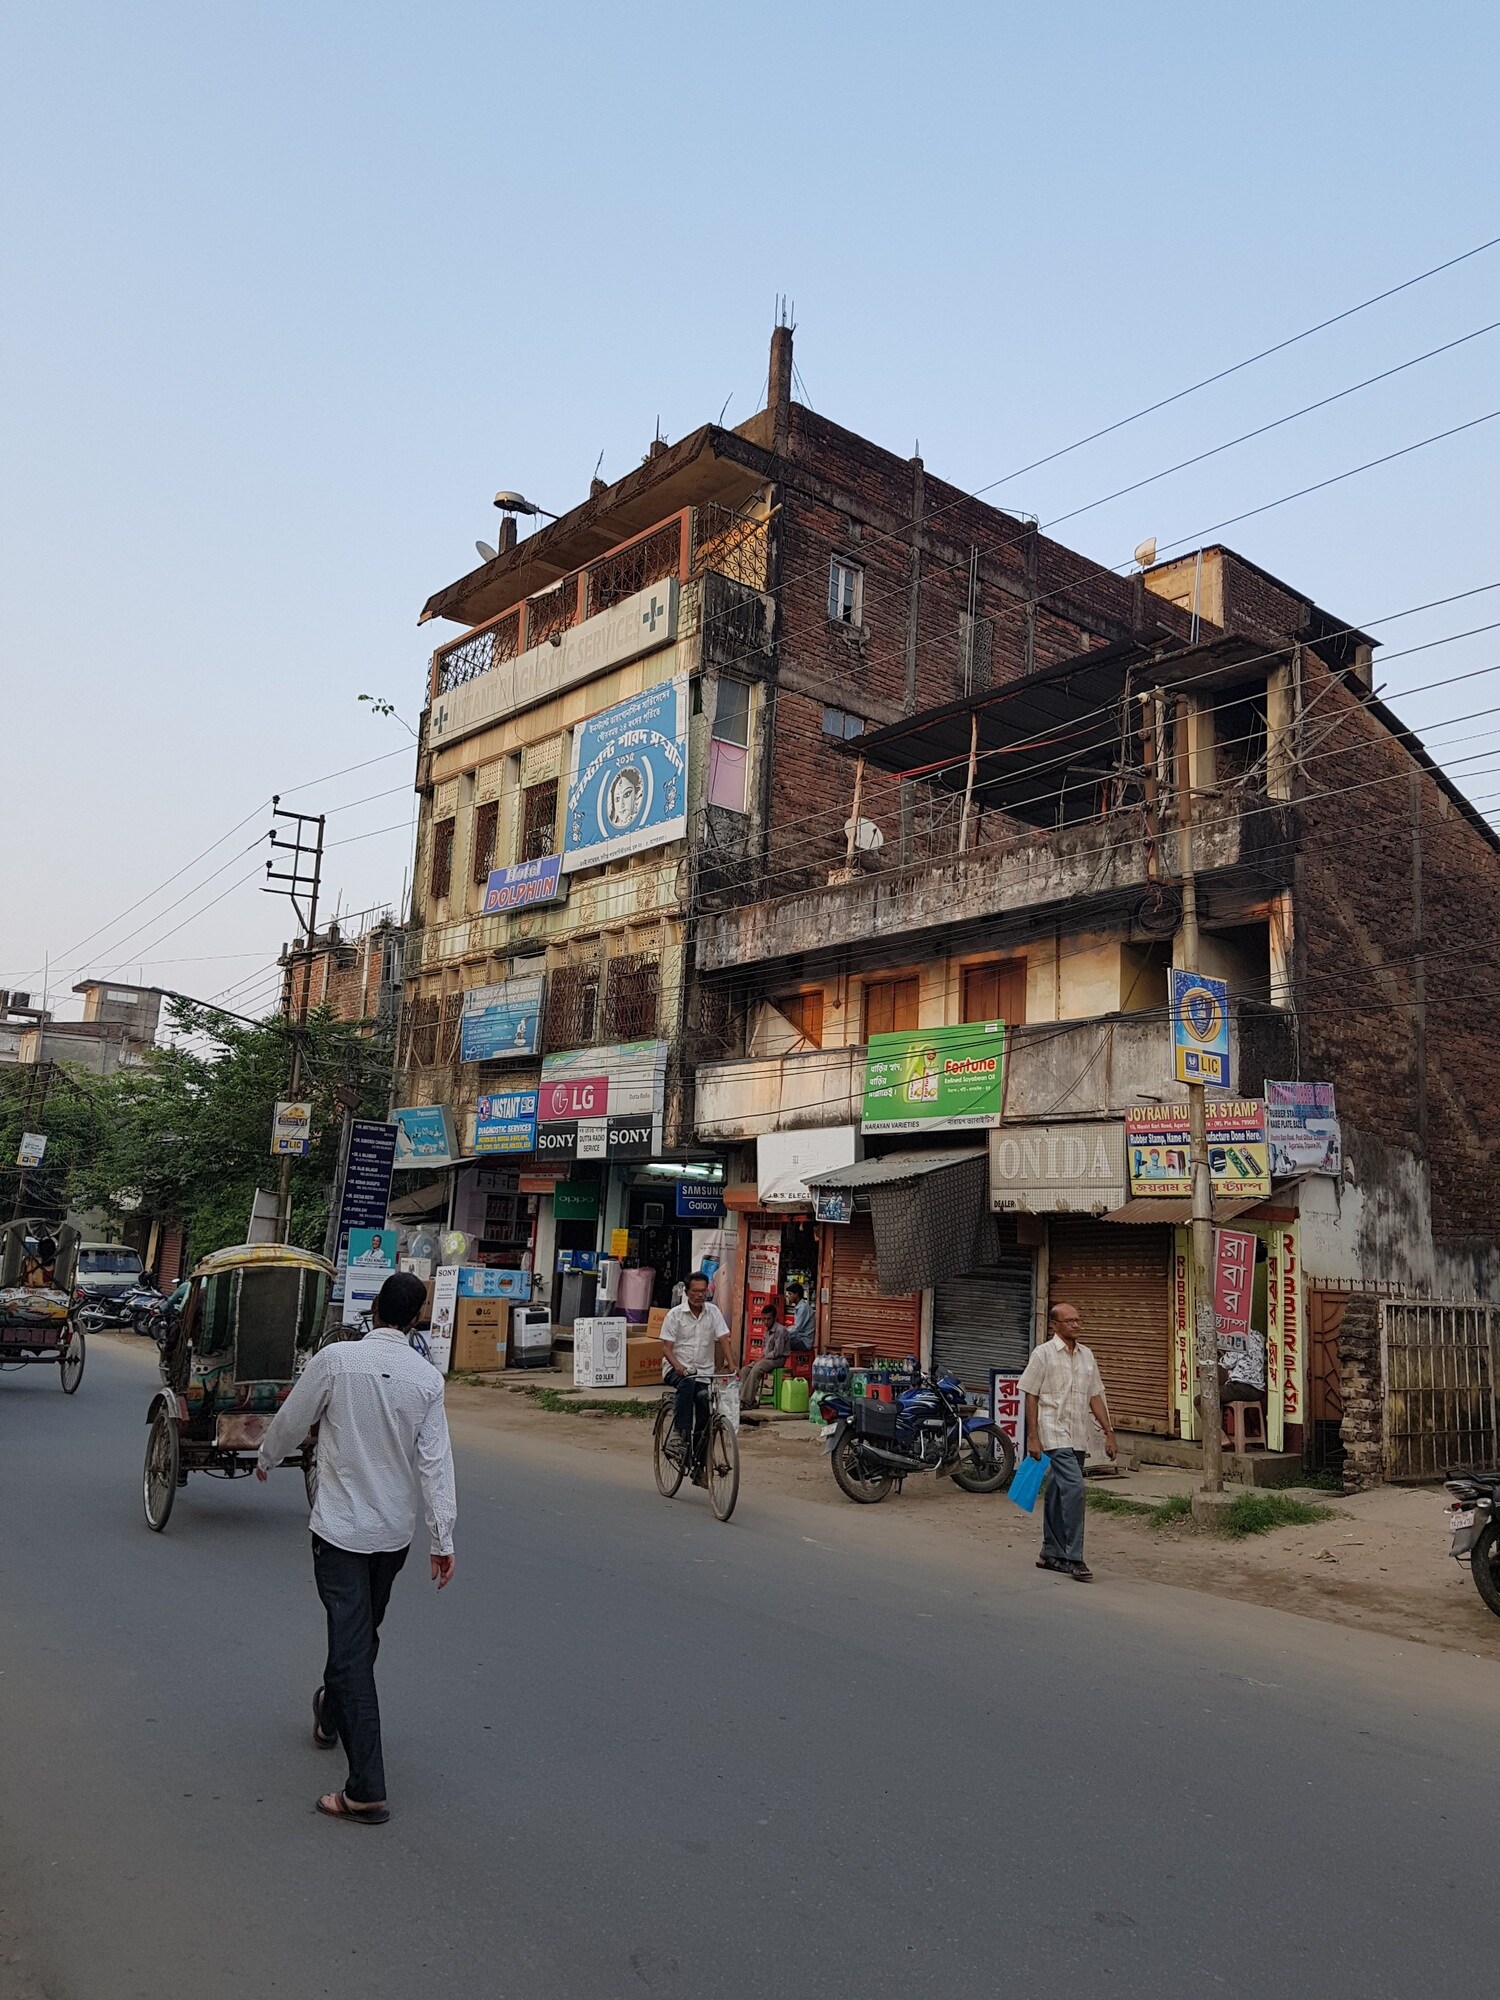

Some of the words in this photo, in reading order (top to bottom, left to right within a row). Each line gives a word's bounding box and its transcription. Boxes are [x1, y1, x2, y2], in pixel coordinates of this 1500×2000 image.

[577, 611, 639, 664] SERVICES
[505, 860, 542, 883] Hotel
[487, 876, 555, 910] DOLPHIN
[945, 1056, 996, 1075] Fortune
[1201, 1057, 1218, 1073] LIC
[572, 1085, 595, 1110] LG
[491, 1097, 520, 1119] INSTANT
[1127, 1105, 1171, 1122] JOYRAM
[1220, 1101, 1258, 1118] STAMP
[508, 1124, 531, 1133] SERVICES
[865, 1122, 891, 1131] NARAYAN
[891, 1121, 920, 1129] VARIETIES
[538, 1134, 575, 1149] SONY
[609, 1129, 651, 1144] SONY
[1166, 1132, 1182, 1141] Name
[1231, 1131, 1244, 1140] Done
[583, 1144, 600, 1152] SERVICE
[998, 1134, 1114, 1180] ONIDA
[1135, 1183, 1179, 1192] জয়রাম
[688, 1201, 717, 1212] Galaxy
[438, 1269, 457, 1277] SONY
[1177, 1256, 1186, 1331] RUBBER
[1283, 1234, 1297, 1353] RUBBER
[1283, 1354, 1299, 1414] STAMP
